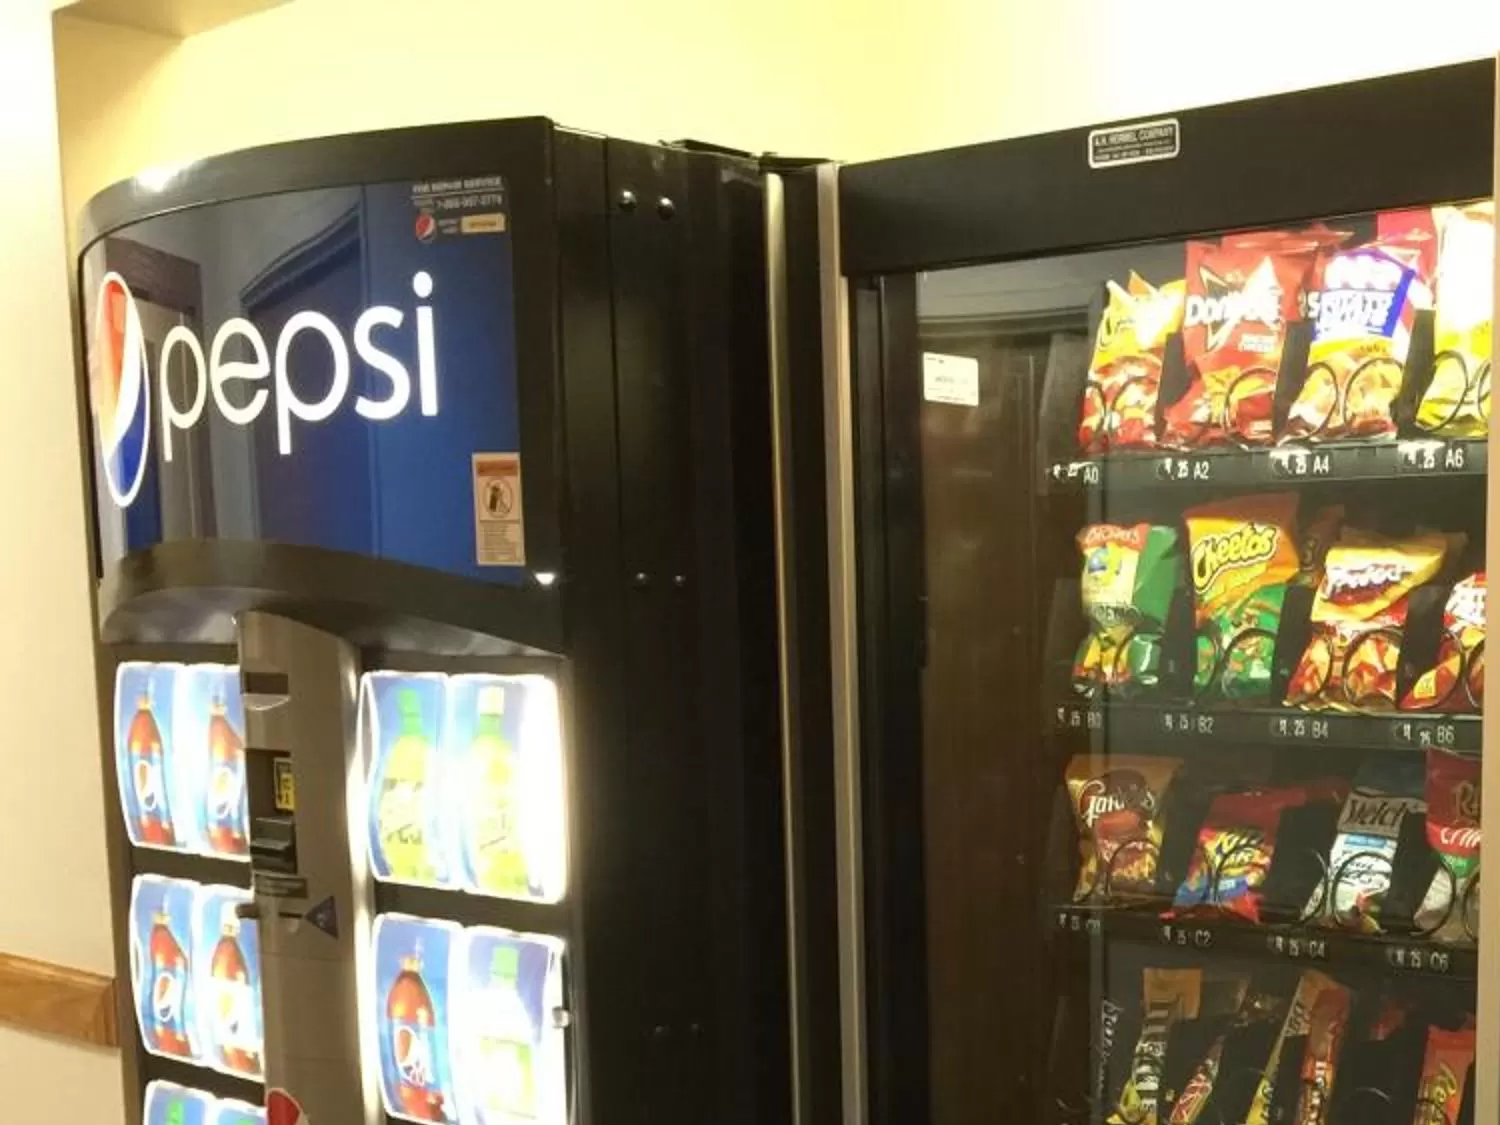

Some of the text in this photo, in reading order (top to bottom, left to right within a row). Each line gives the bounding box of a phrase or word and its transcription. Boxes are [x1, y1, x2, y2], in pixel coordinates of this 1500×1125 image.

[159, 271, 438, 462] pepsi
[1313, 455, 1330, 474] A4
[1445, 448, 1464, 468] A6
[1193, 461, 1210, 480] A2
[1193, 522, 1278, 589] Cheetos
[1197, 715, 1214, 734] B2
[1311, 721, 1328, 739] B4
[1437, 725, 1455, 744] B6
